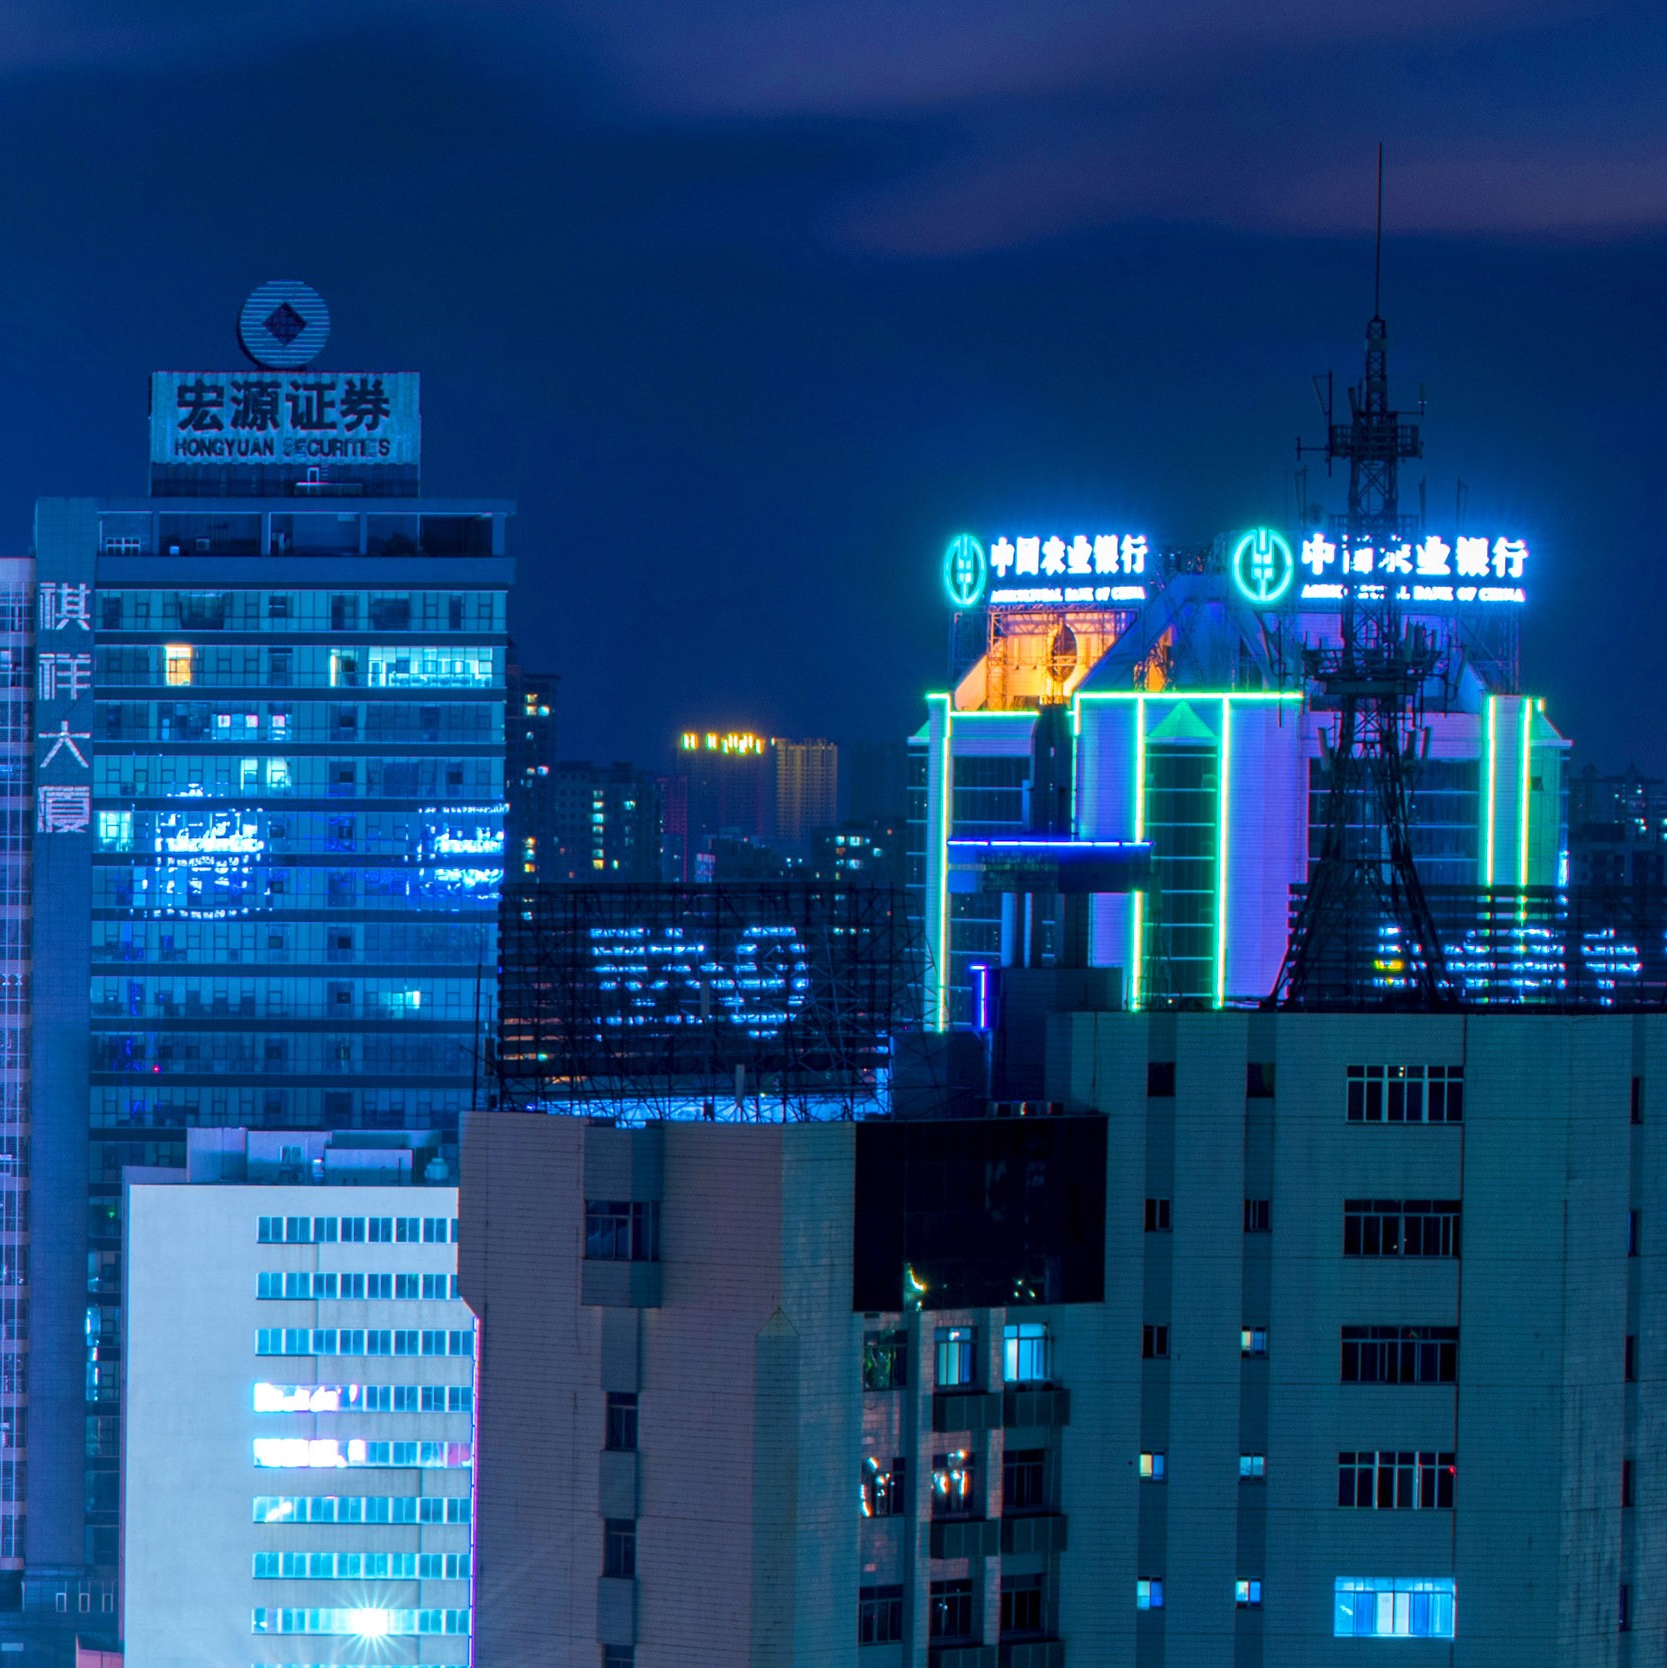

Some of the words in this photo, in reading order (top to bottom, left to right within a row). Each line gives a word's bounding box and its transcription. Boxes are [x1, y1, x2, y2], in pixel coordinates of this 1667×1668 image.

[176, 379, 391, 432] 宏源证券
[175, 438, 275, 457] HONGYUAN
[991, 534, 1148, 577] 中国农业银行
